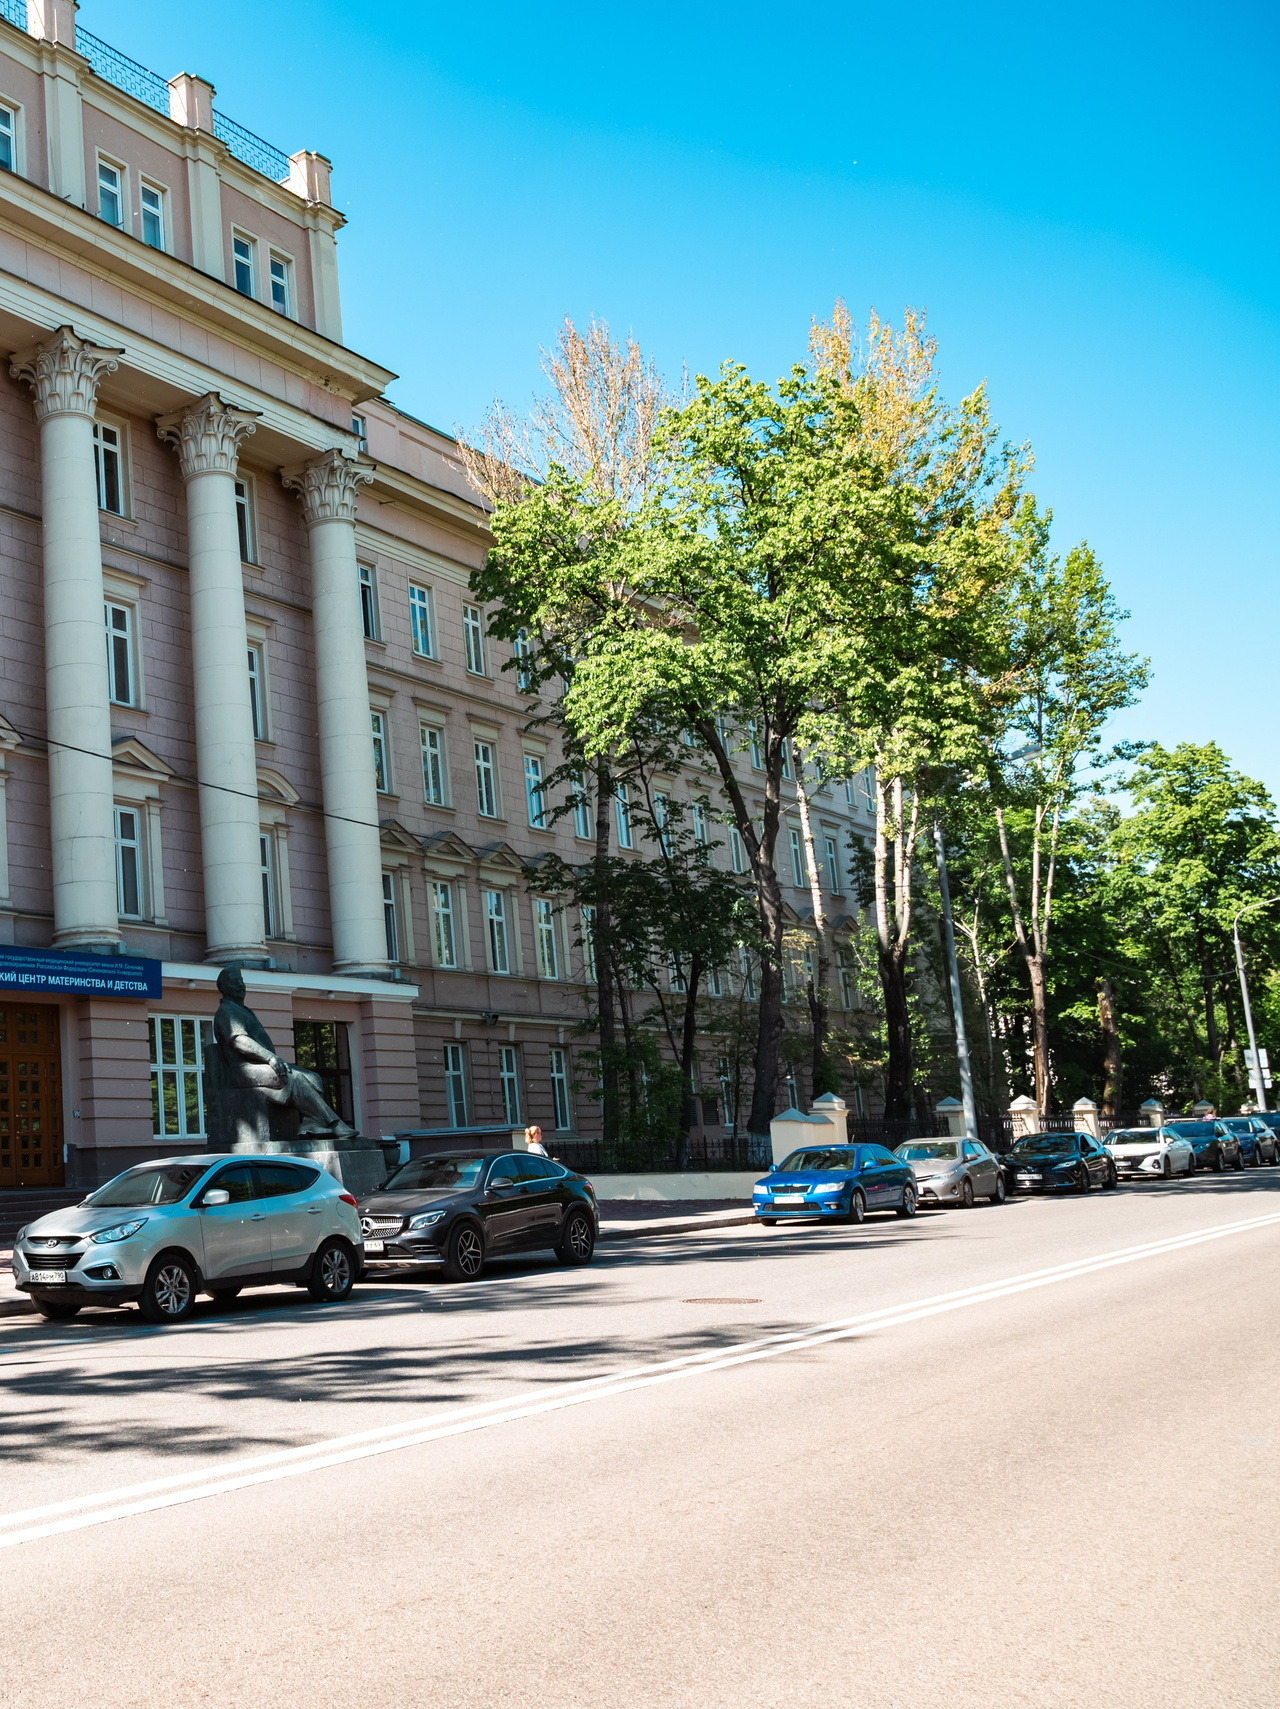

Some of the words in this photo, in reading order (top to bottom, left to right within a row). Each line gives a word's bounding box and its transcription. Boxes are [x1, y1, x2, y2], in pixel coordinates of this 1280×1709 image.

[36, 963, 62, 971] Российской
[63, 965, 88, 973] Федерации
[18, 973, 47, 984] ЦЕНТР
[48, 975, 106, 988] МАТЕРИНСТВА
[107, 980, 113, 988] И
[114, 980, 148, 991] ДЕТСТВА
